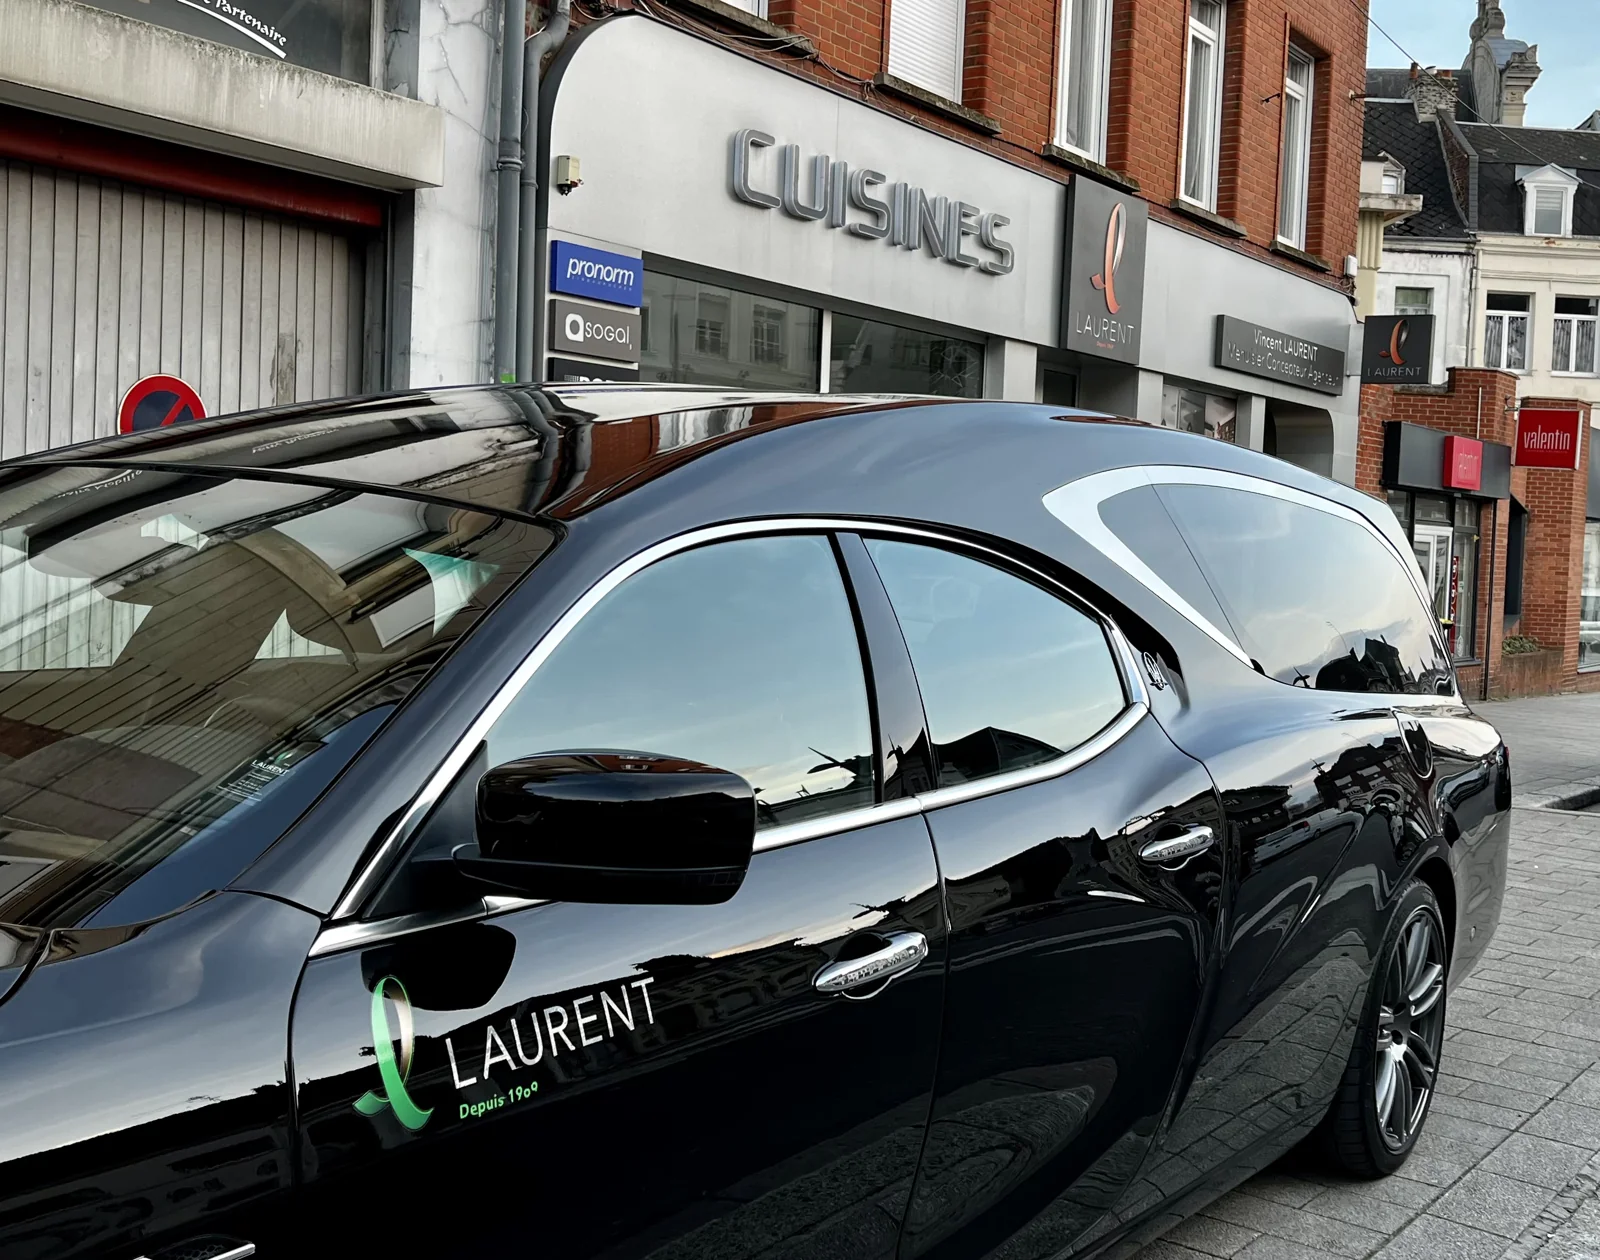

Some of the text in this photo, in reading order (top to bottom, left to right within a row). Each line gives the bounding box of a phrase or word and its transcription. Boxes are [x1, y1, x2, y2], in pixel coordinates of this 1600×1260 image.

[215, 0, 287, 46] Partenaire
[732, 128, 1016, 276] CUISINES
[566, 257, 635, 286] pronorm
[1076, 311, 1135, 345] LAURENT
[1253, 328, 1318, 362] Vincent LAURENT
[1367, 366, 1422, 377] LAURENT
[1523, 424, 1571, 451] valentin
[251, 759, 291, 776] LAURENT
[445, 976, 655, 1090] LAURENT
[459, 1093, 506, 1119] Depuis
